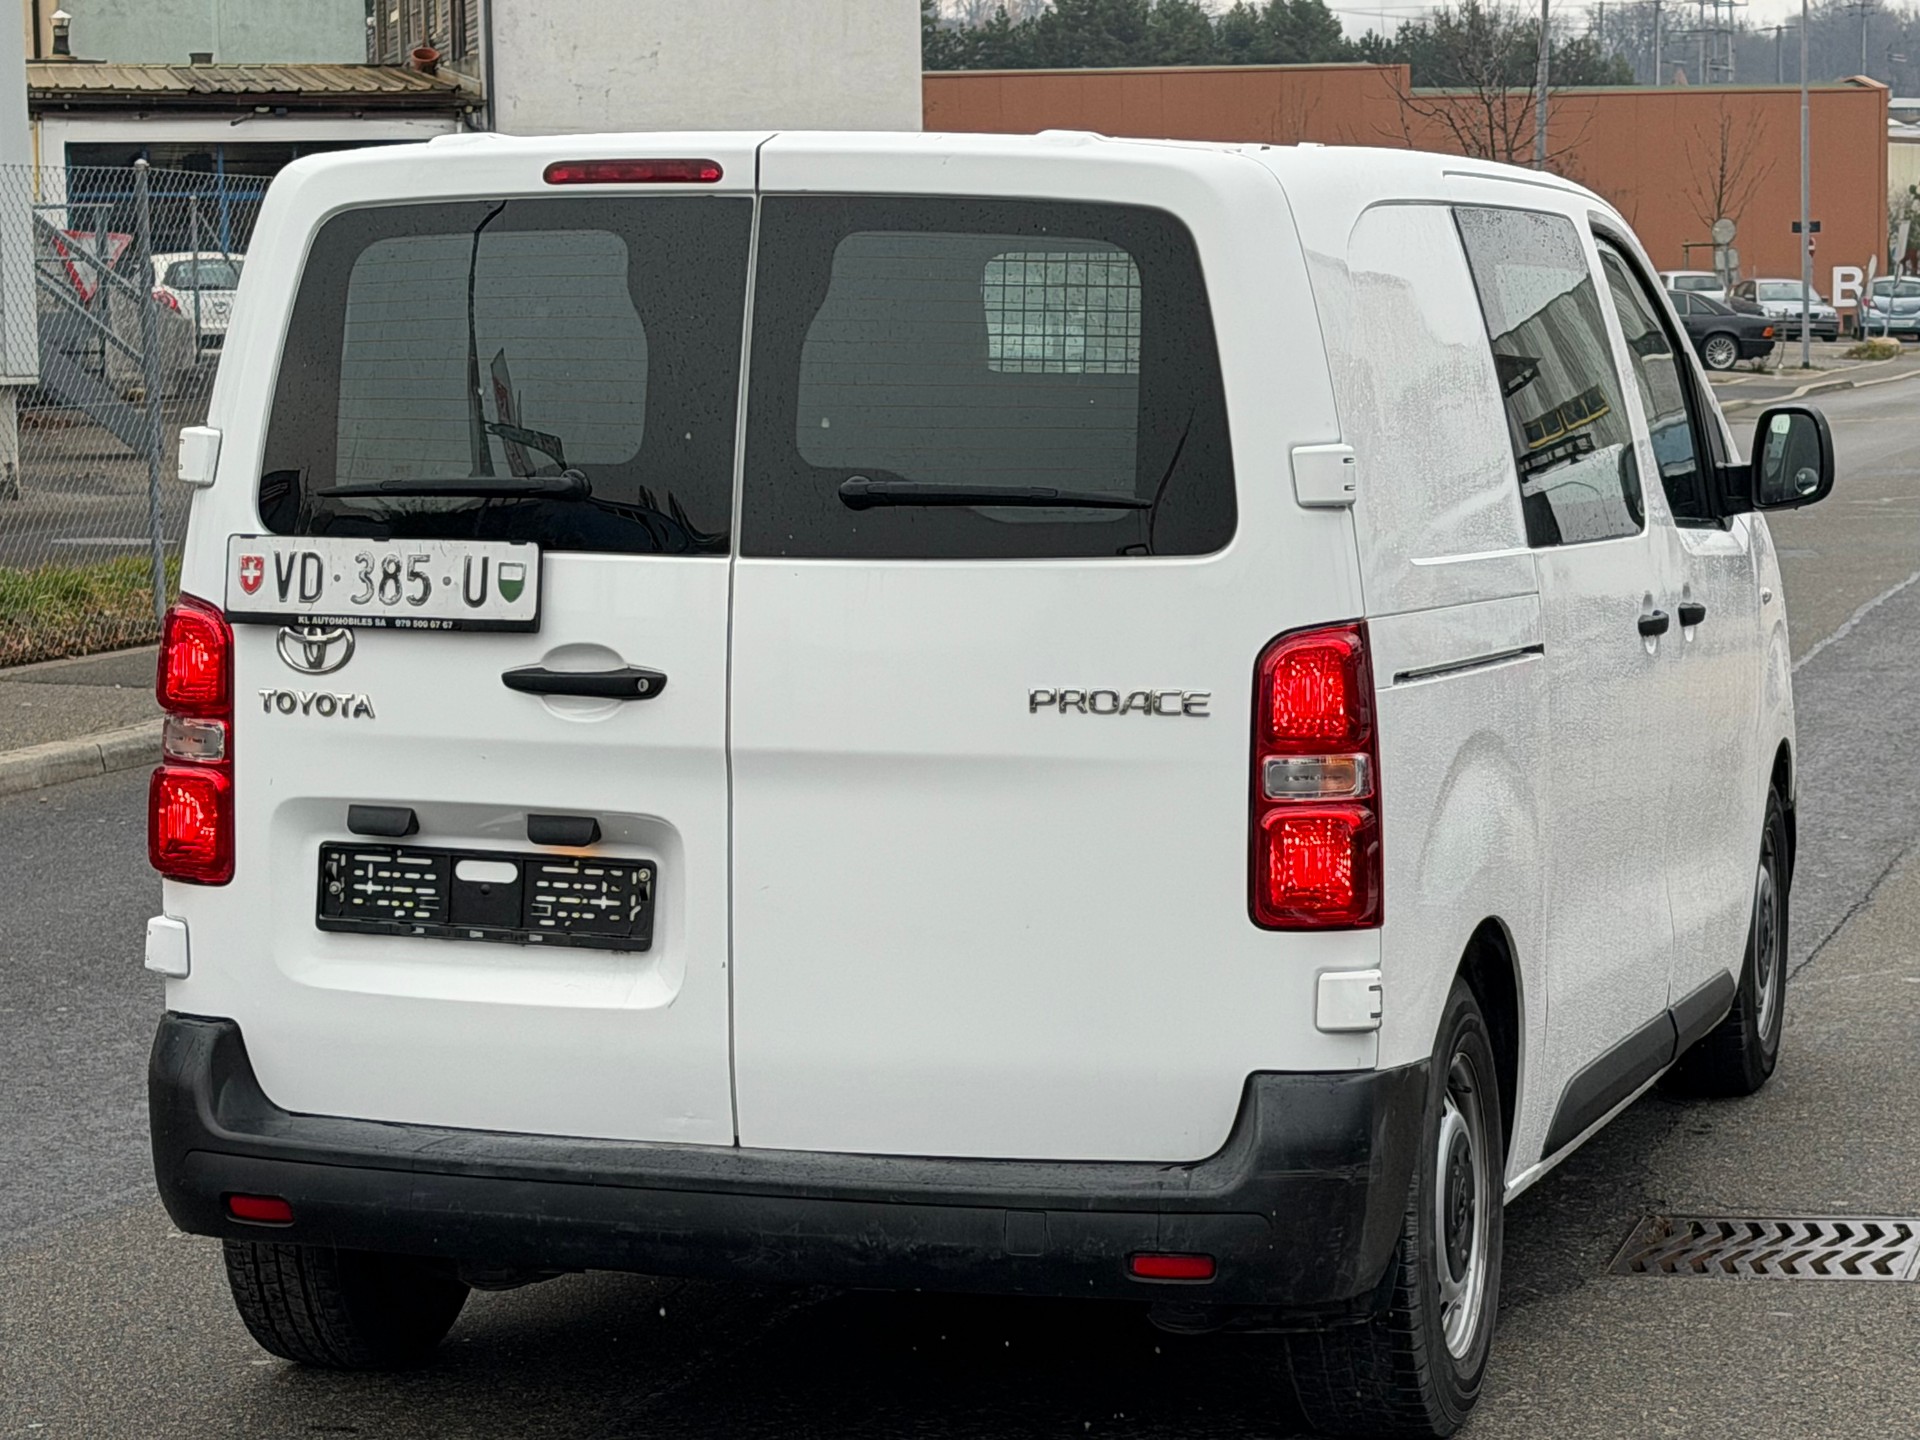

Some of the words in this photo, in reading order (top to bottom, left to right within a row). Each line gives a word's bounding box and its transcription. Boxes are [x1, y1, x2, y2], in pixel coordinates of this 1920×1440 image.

[1832, 266, 1864, 307] B
[311, 616, 373, 626] AUTOMOBILES
[375, 617, 387, 627] SA
[258, 689, 375, 719] TOYOTA
[1029, 688, 1211, 717] PROACE
